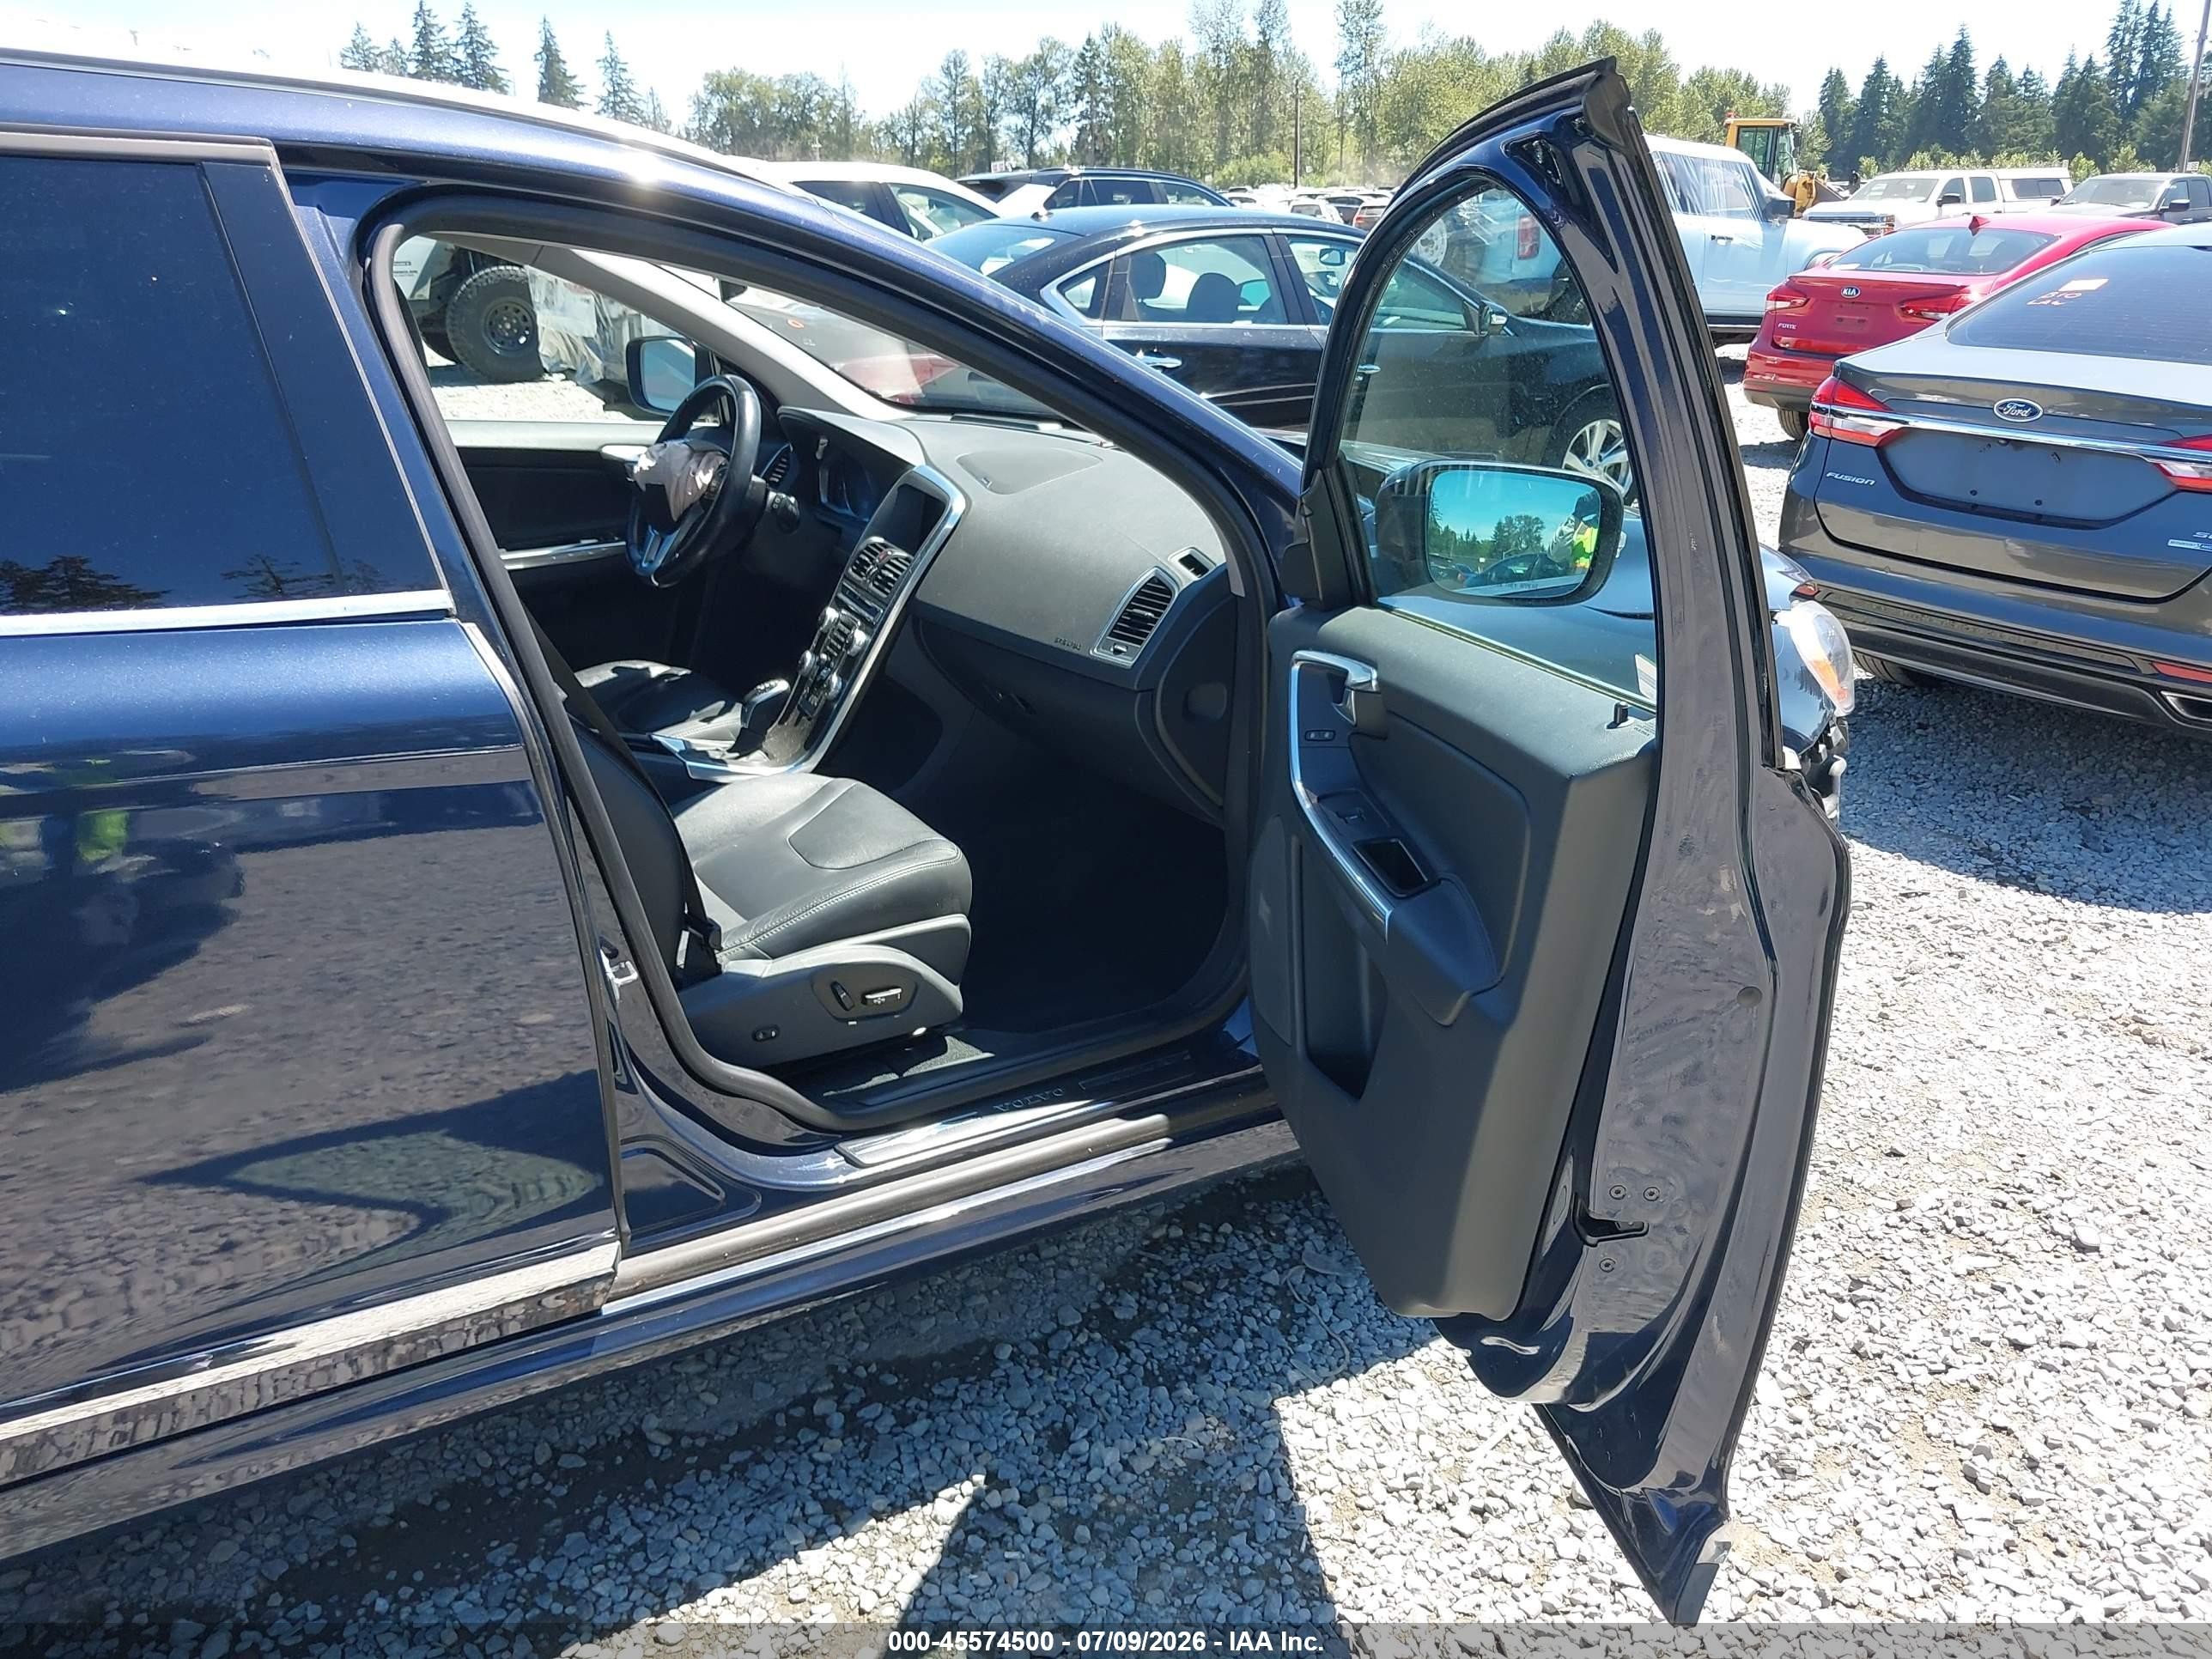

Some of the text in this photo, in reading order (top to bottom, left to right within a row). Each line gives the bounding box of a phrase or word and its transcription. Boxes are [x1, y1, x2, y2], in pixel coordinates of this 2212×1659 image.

[1842, 288, 1856, 296] KIA
[2002, 402, 2032, 417] Ford
[1826, 471, 1876, 486] FUSION
